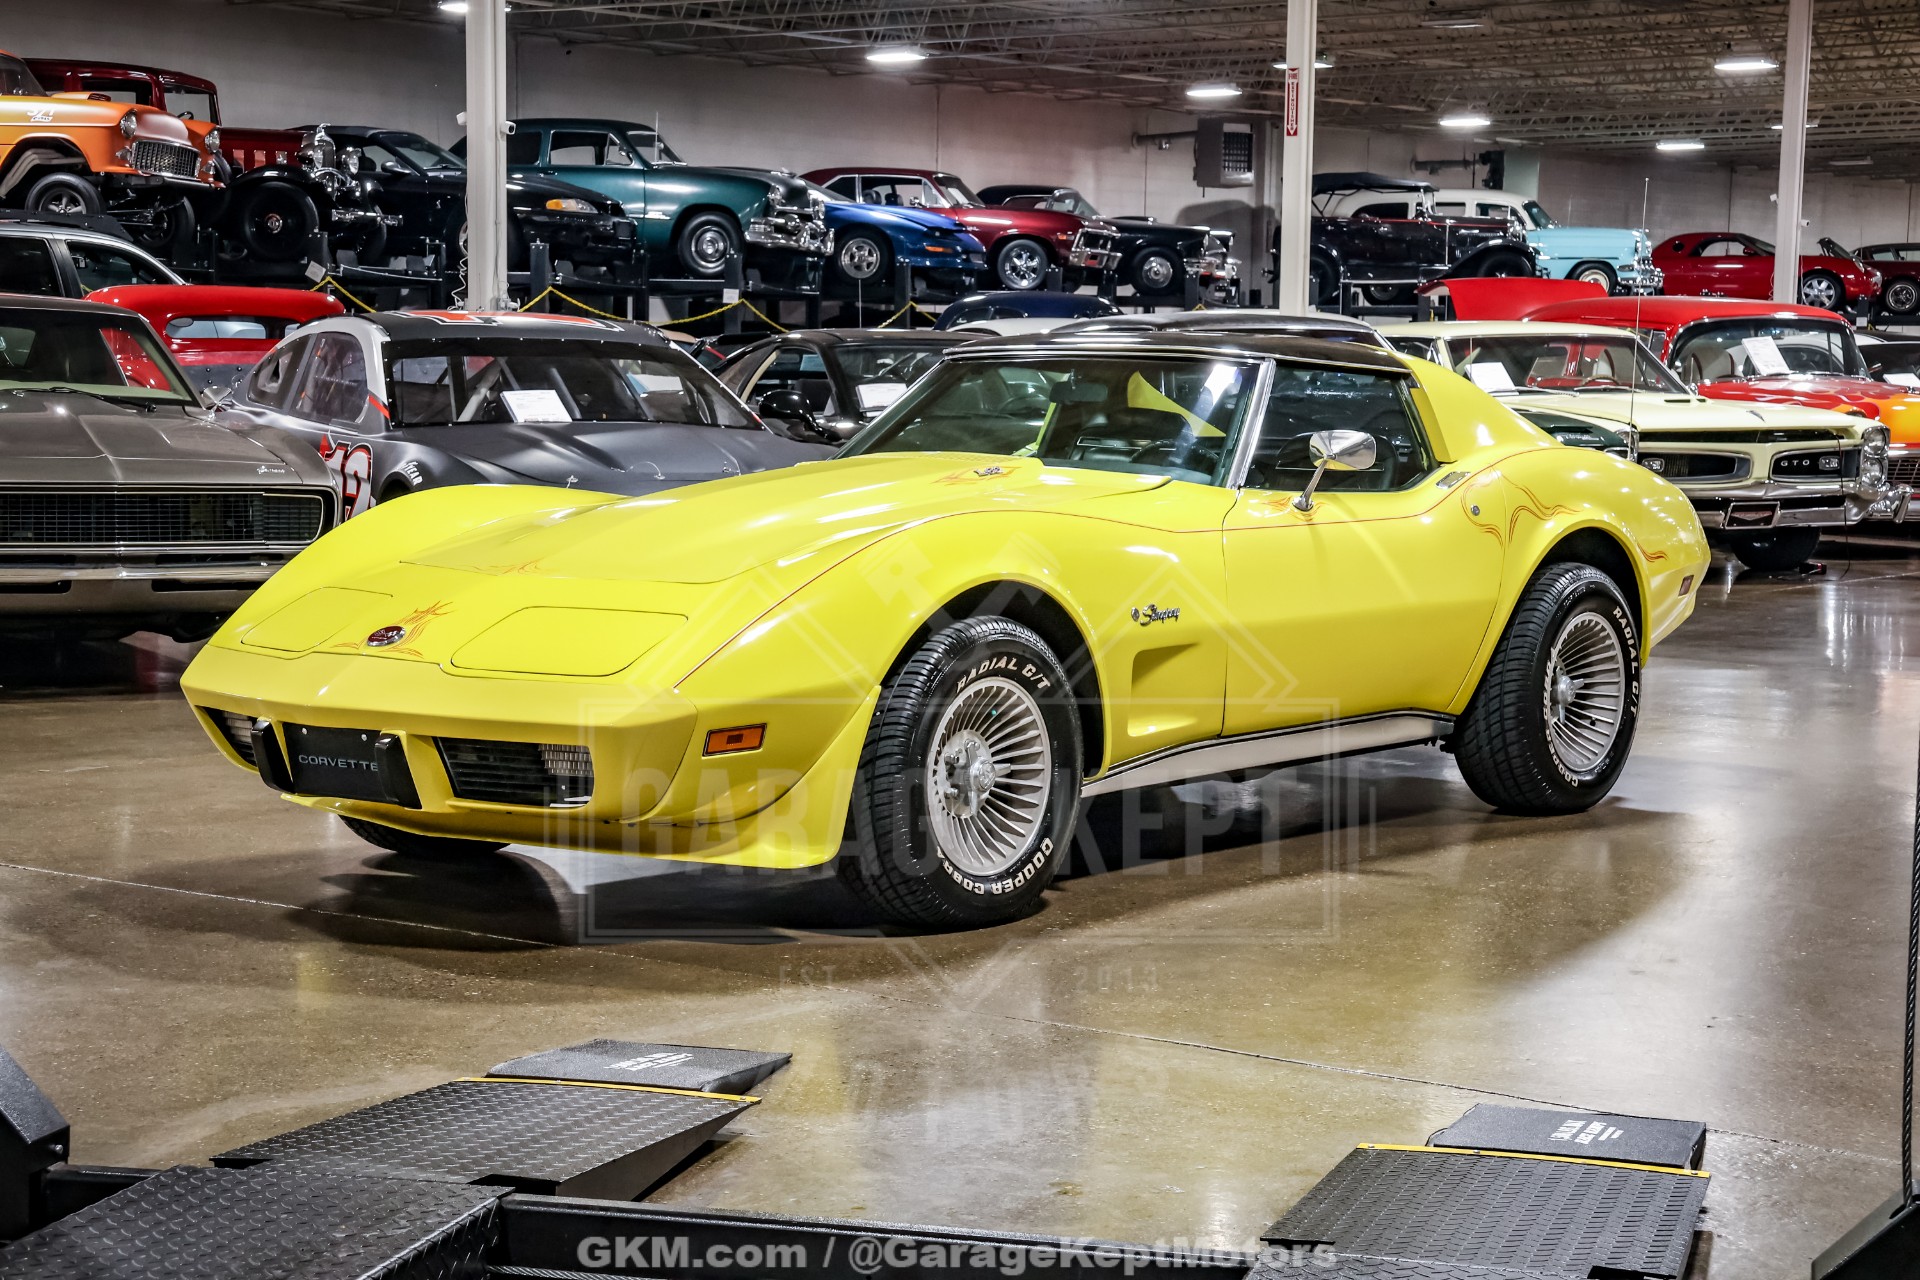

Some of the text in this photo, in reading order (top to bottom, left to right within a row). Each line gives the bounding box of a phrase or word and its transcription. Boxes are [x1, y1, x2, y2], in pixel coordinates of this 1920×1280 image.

[1780, 458, 1810, 467] GTO
[1140, 604, 1180, 627] Stingray
[956, 655, 1051, 694] RADIAL G/T
[1612, 605, 1639, 718] RADIAL G/T
[298, 754, 379, 772] CORVETTE
[936, 837, 1054, 896] COOPER COBRA
